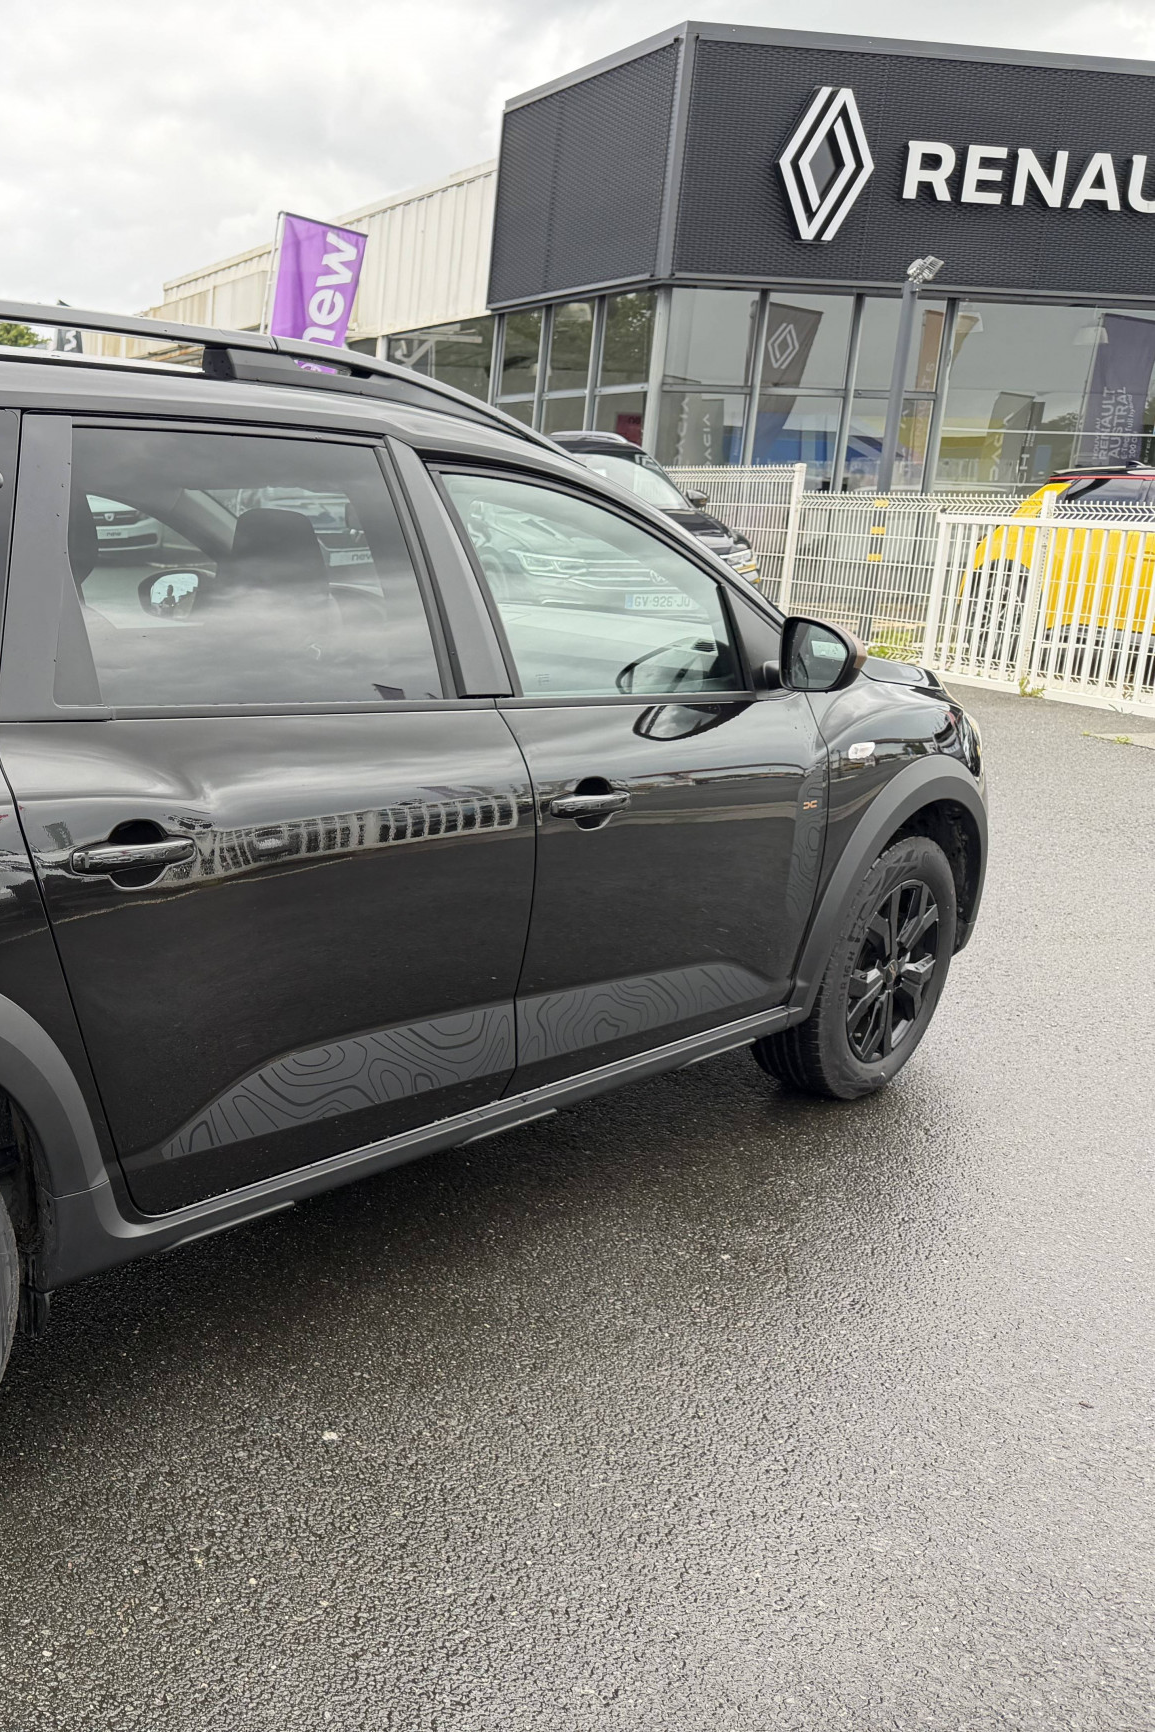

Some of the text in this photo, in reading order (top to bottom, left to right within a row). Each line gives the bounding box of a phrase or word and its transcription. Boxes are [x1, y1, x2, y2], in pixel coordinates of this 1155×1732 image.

[989, 412, 1014, 481] DACA
[1092, 417, 1101, 459] NOUVAU
[1098, 386, 1116, 460] RENAULT
[1109, 386, 1128, 459] AUSTRAL
